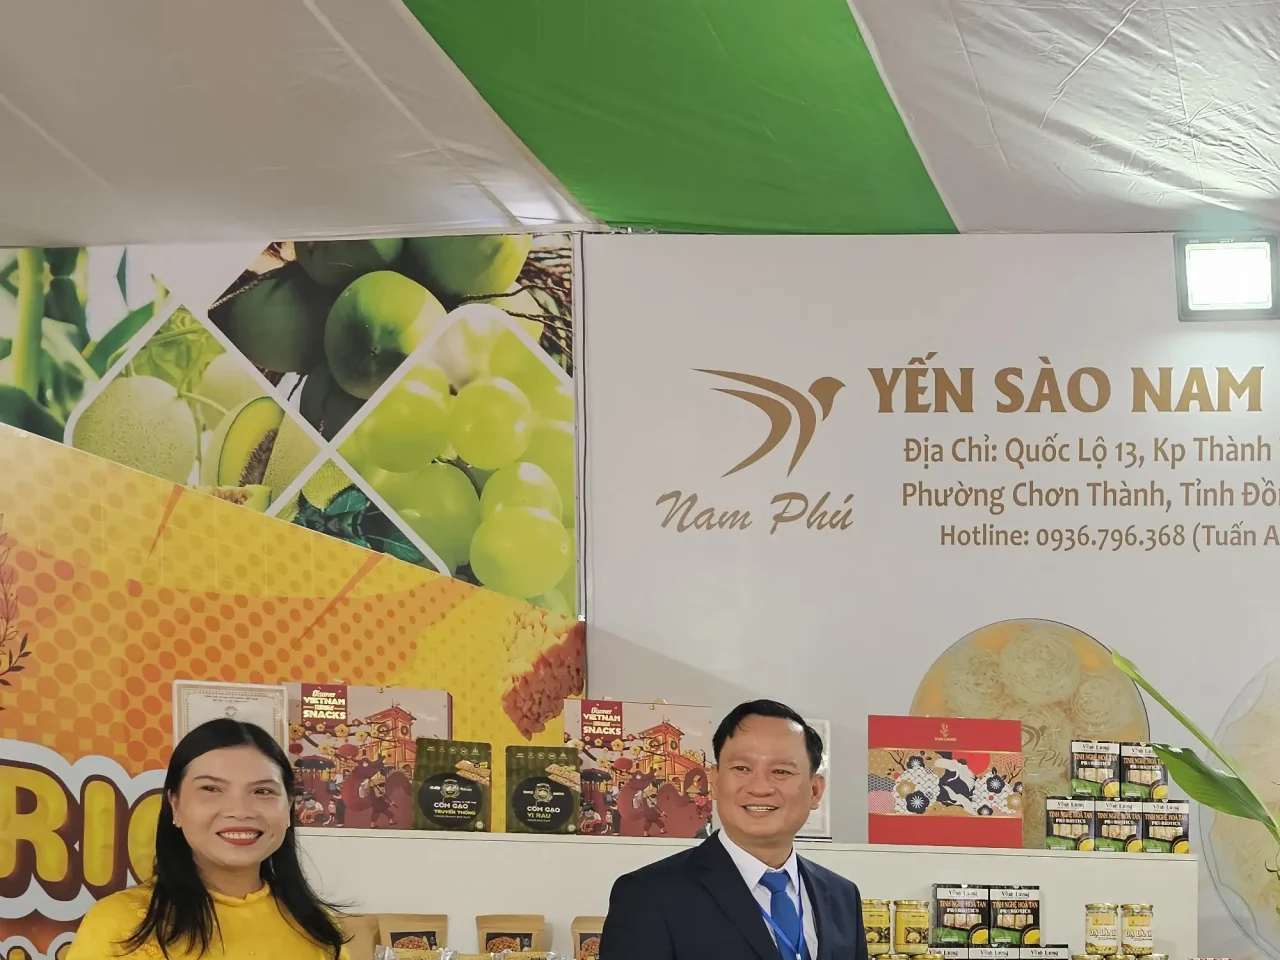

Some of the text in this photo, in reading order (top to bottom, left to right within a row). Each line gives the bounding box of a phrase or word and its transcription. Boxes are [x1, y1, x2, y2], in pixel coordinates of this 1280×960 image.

[868, 352, 974, 413] YẾN
[994, 356, 1111, 413] SÀO
[1130, 366, 1264, 412] NAM
[904, 436, 944, 469] Địa
[952, 434, 997, 462] Chỉ:
[1005, 433, 1070, 469] Quốc
[1079, 436, 1107, 469] Lộ
[1115, 441, 1145, 469] 13,
[1154, 437, 1186, 469] Kp
[1194, 435, 1271, 462] Thành
[656, 490, 854, 535] Nam Phú
[902, 481, 1005, 515] Phường
[1012, 481, 1079, 507] Chơn
[1087, 480, 1172, 513] Thành,
[1180, 478, 1234, 507] Tỉnh
[941, 524, 1028, 546] Hotline:
[1037, 525, 1185, 552] 0936.796.368
[1193, 521, 1256, 553] (Tuấn
[303, 697, 346, 705] VIETNAM
[303, 710, 346, 720] SNACKS
[583, 726, 621, 735] SNACKS
